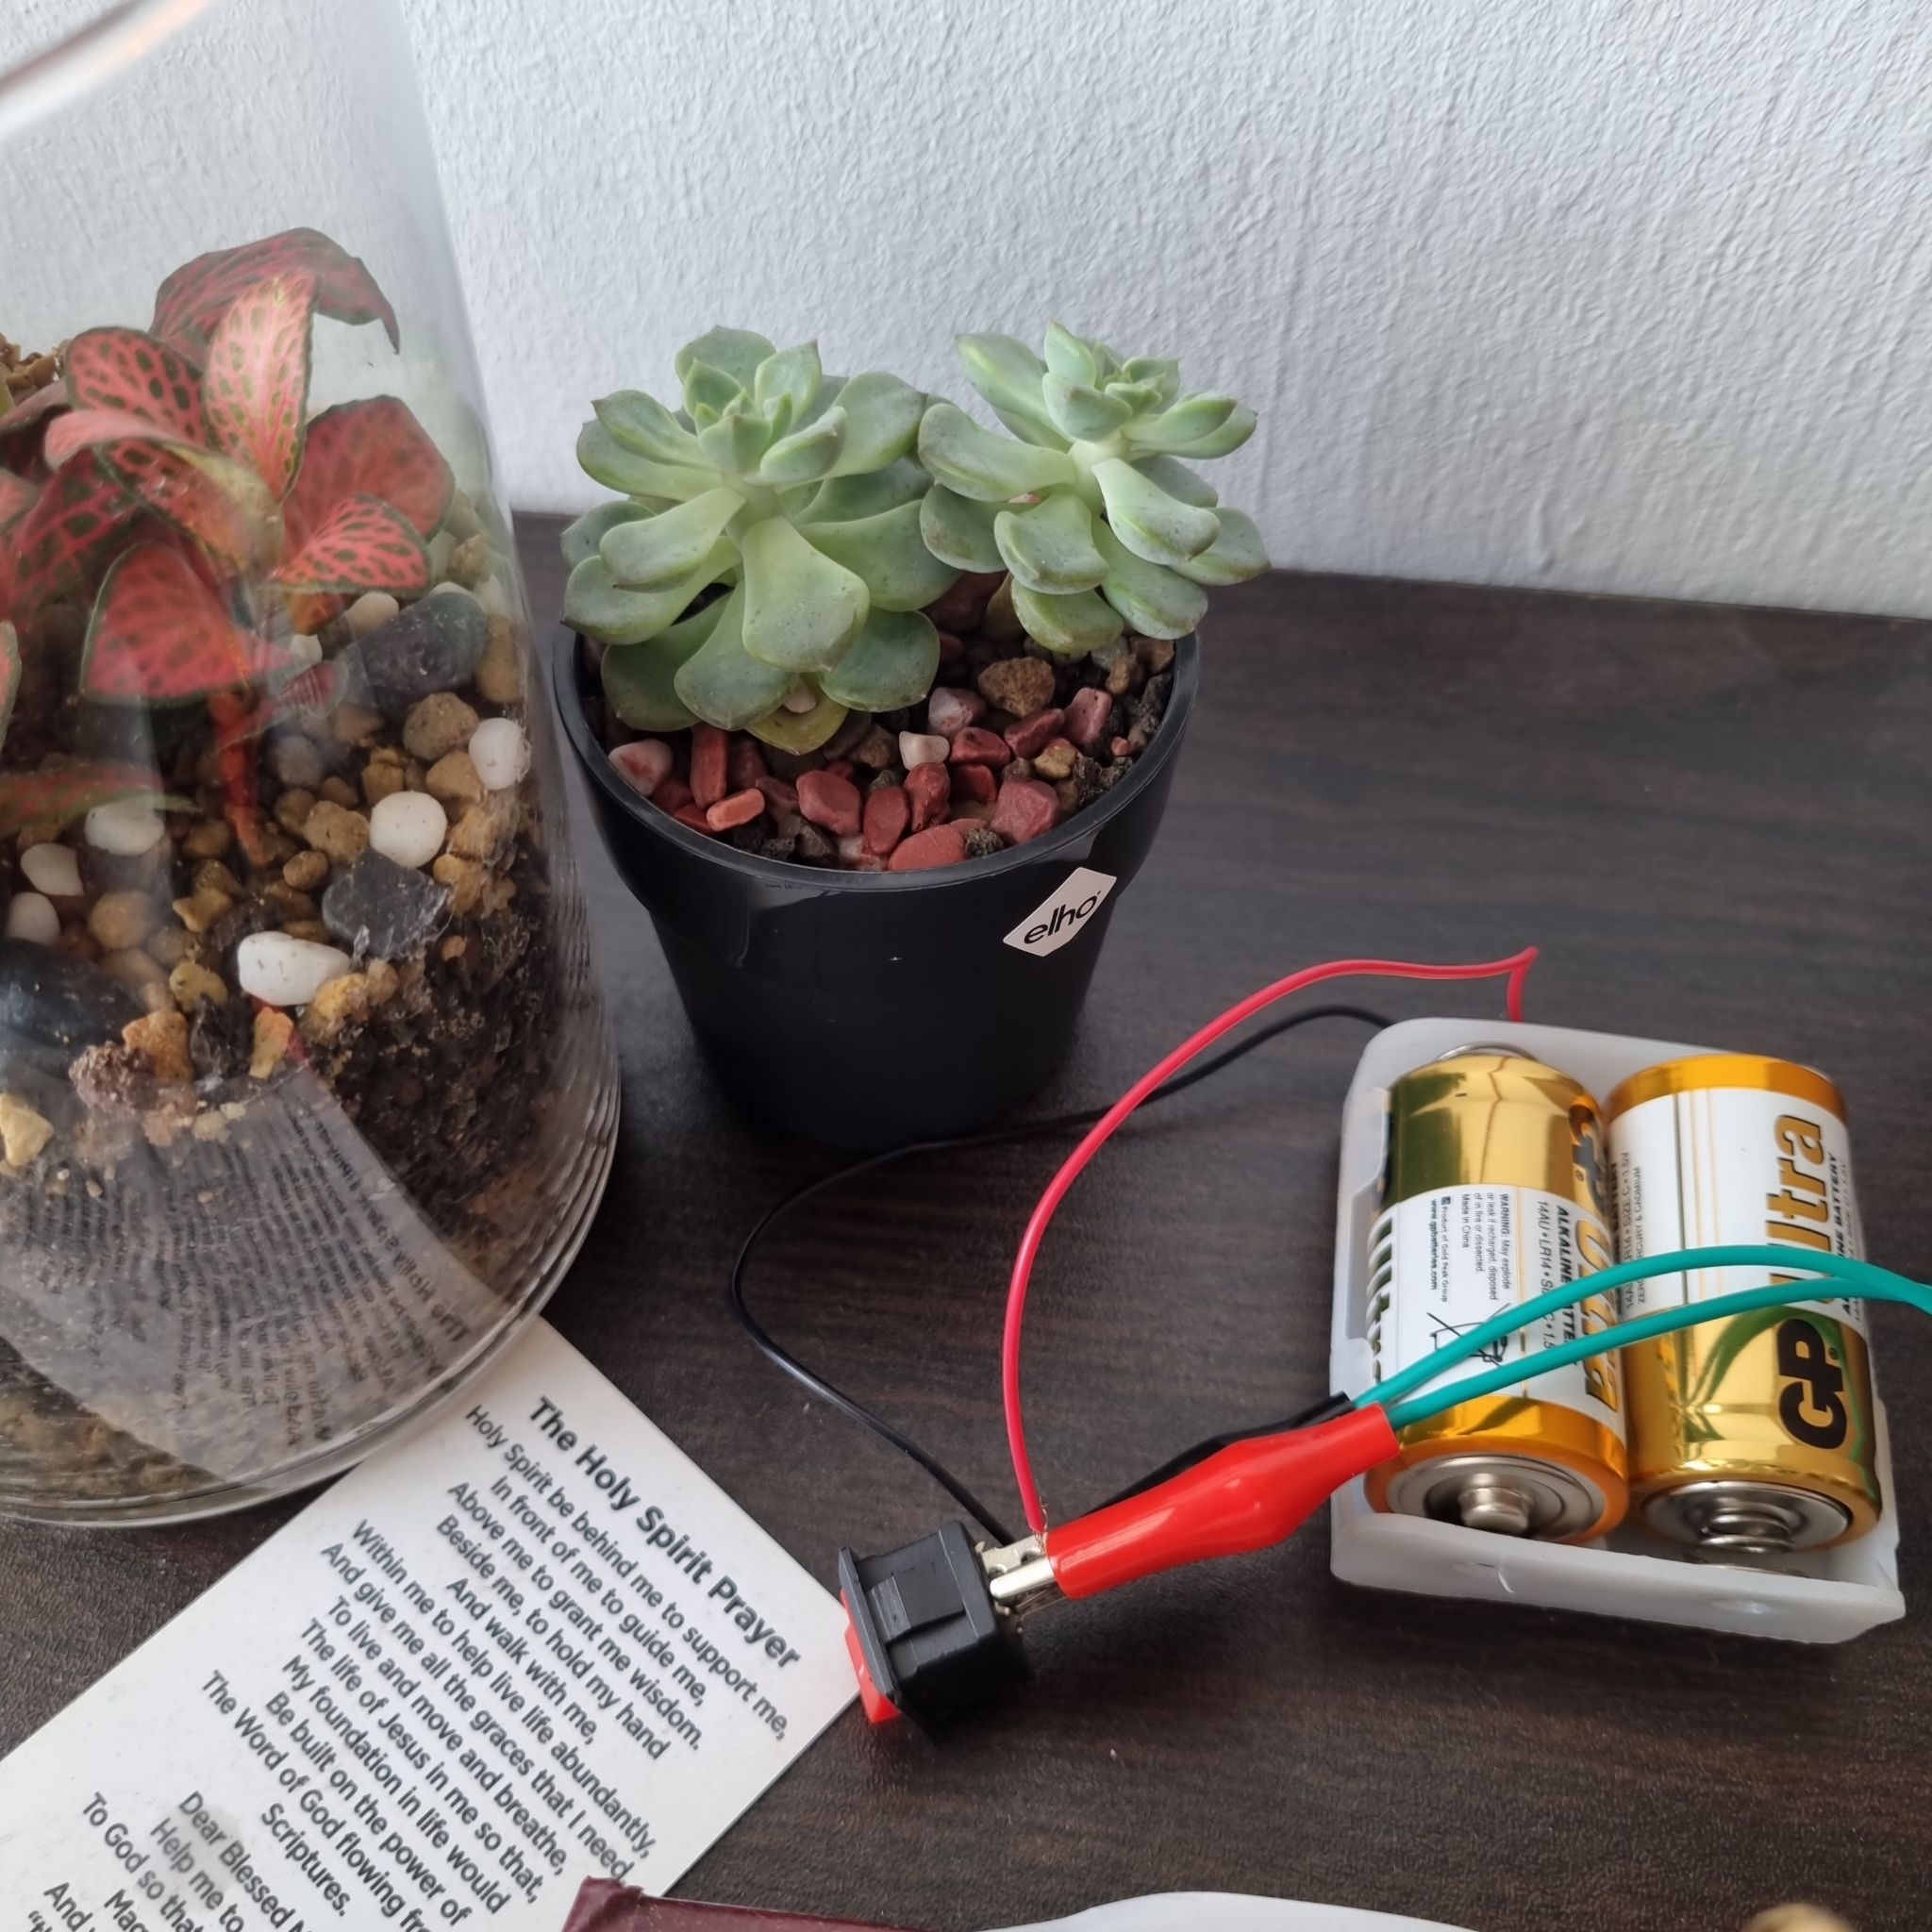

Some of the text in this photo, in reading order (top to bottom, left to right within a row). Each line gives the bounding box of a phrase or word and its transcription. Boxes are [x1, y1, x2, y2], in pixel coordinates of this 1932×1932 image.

[1024, 891, 1100, 944] elho
[1461, 1194, 1470, 1214] Made
[1461, 1225, 1471, 1248] China
[1487, 1202, 1495, 1216] leak
[1499, 1194, 1510, 1289] WARNING: May explode
[1537, 1201, 1550, 1230] 14AU
[1539, 1239, 1552, 1268] LR14
[1557, 1206, 1573, 1284] ALKALINE
[1488, 1266, 1498, 1300] disposed
[1777, 1319, 1847, 1449] GP
[466, 1406, 788, 1740] Holy Spirit be behind me to support me,
[491, 1475, 707, 1707] In front of me to guide me,
[530, 1396, 801, 1668] The Holy Spirit Prayer
[437, 1514, 672, 1760] Beside me, to hold my hand
[445, 1578, 597, 1745] And walk with me,
[447, 1483, 702, 1751] Above me to grant me wisdom.
[321, 1543, 367, 1585] And
[354, 1582, 396, 1624] give
[391, 1621, 425, 1656] me
[420, 1652, 452, 1680] all
[442, 1673, 476, 1712] the
[469, 1709, 535, 1776] graces
[530, 1769, 575, 1819] that
[567, 1809, 587, 1829] I
[328, 1595, 567, 1876] To live and move and breathe,
[352, 1520, 657, 1859] Within me to help live life abundantly,
[202, 1670, 237, 1715] The
[234, 1707, 290, 1771] Word
[278, 1768, 310, 1793] of
[299, 1789, 347, 1840] God
[335, 1831, 407, 1919] flowing
[265, 1690, 473, 1926] Be built on the power of
[282, 1655, 511, 1915] My foundation in life would
[301, 1618, 544, 1904] The life of Jesus in me so that,
[43, 1882, 93, 1932] And
[82, 1791, 108, 1826] To
[104, 1823, 150, 1874] God
[137, 1871, 165, 1900] so
[150, 1818, 244, 1932] Help me to
[178, 1790, 296, 1929] Dear Blessed
[260, 1803, 351, 1917] Scriptures.
